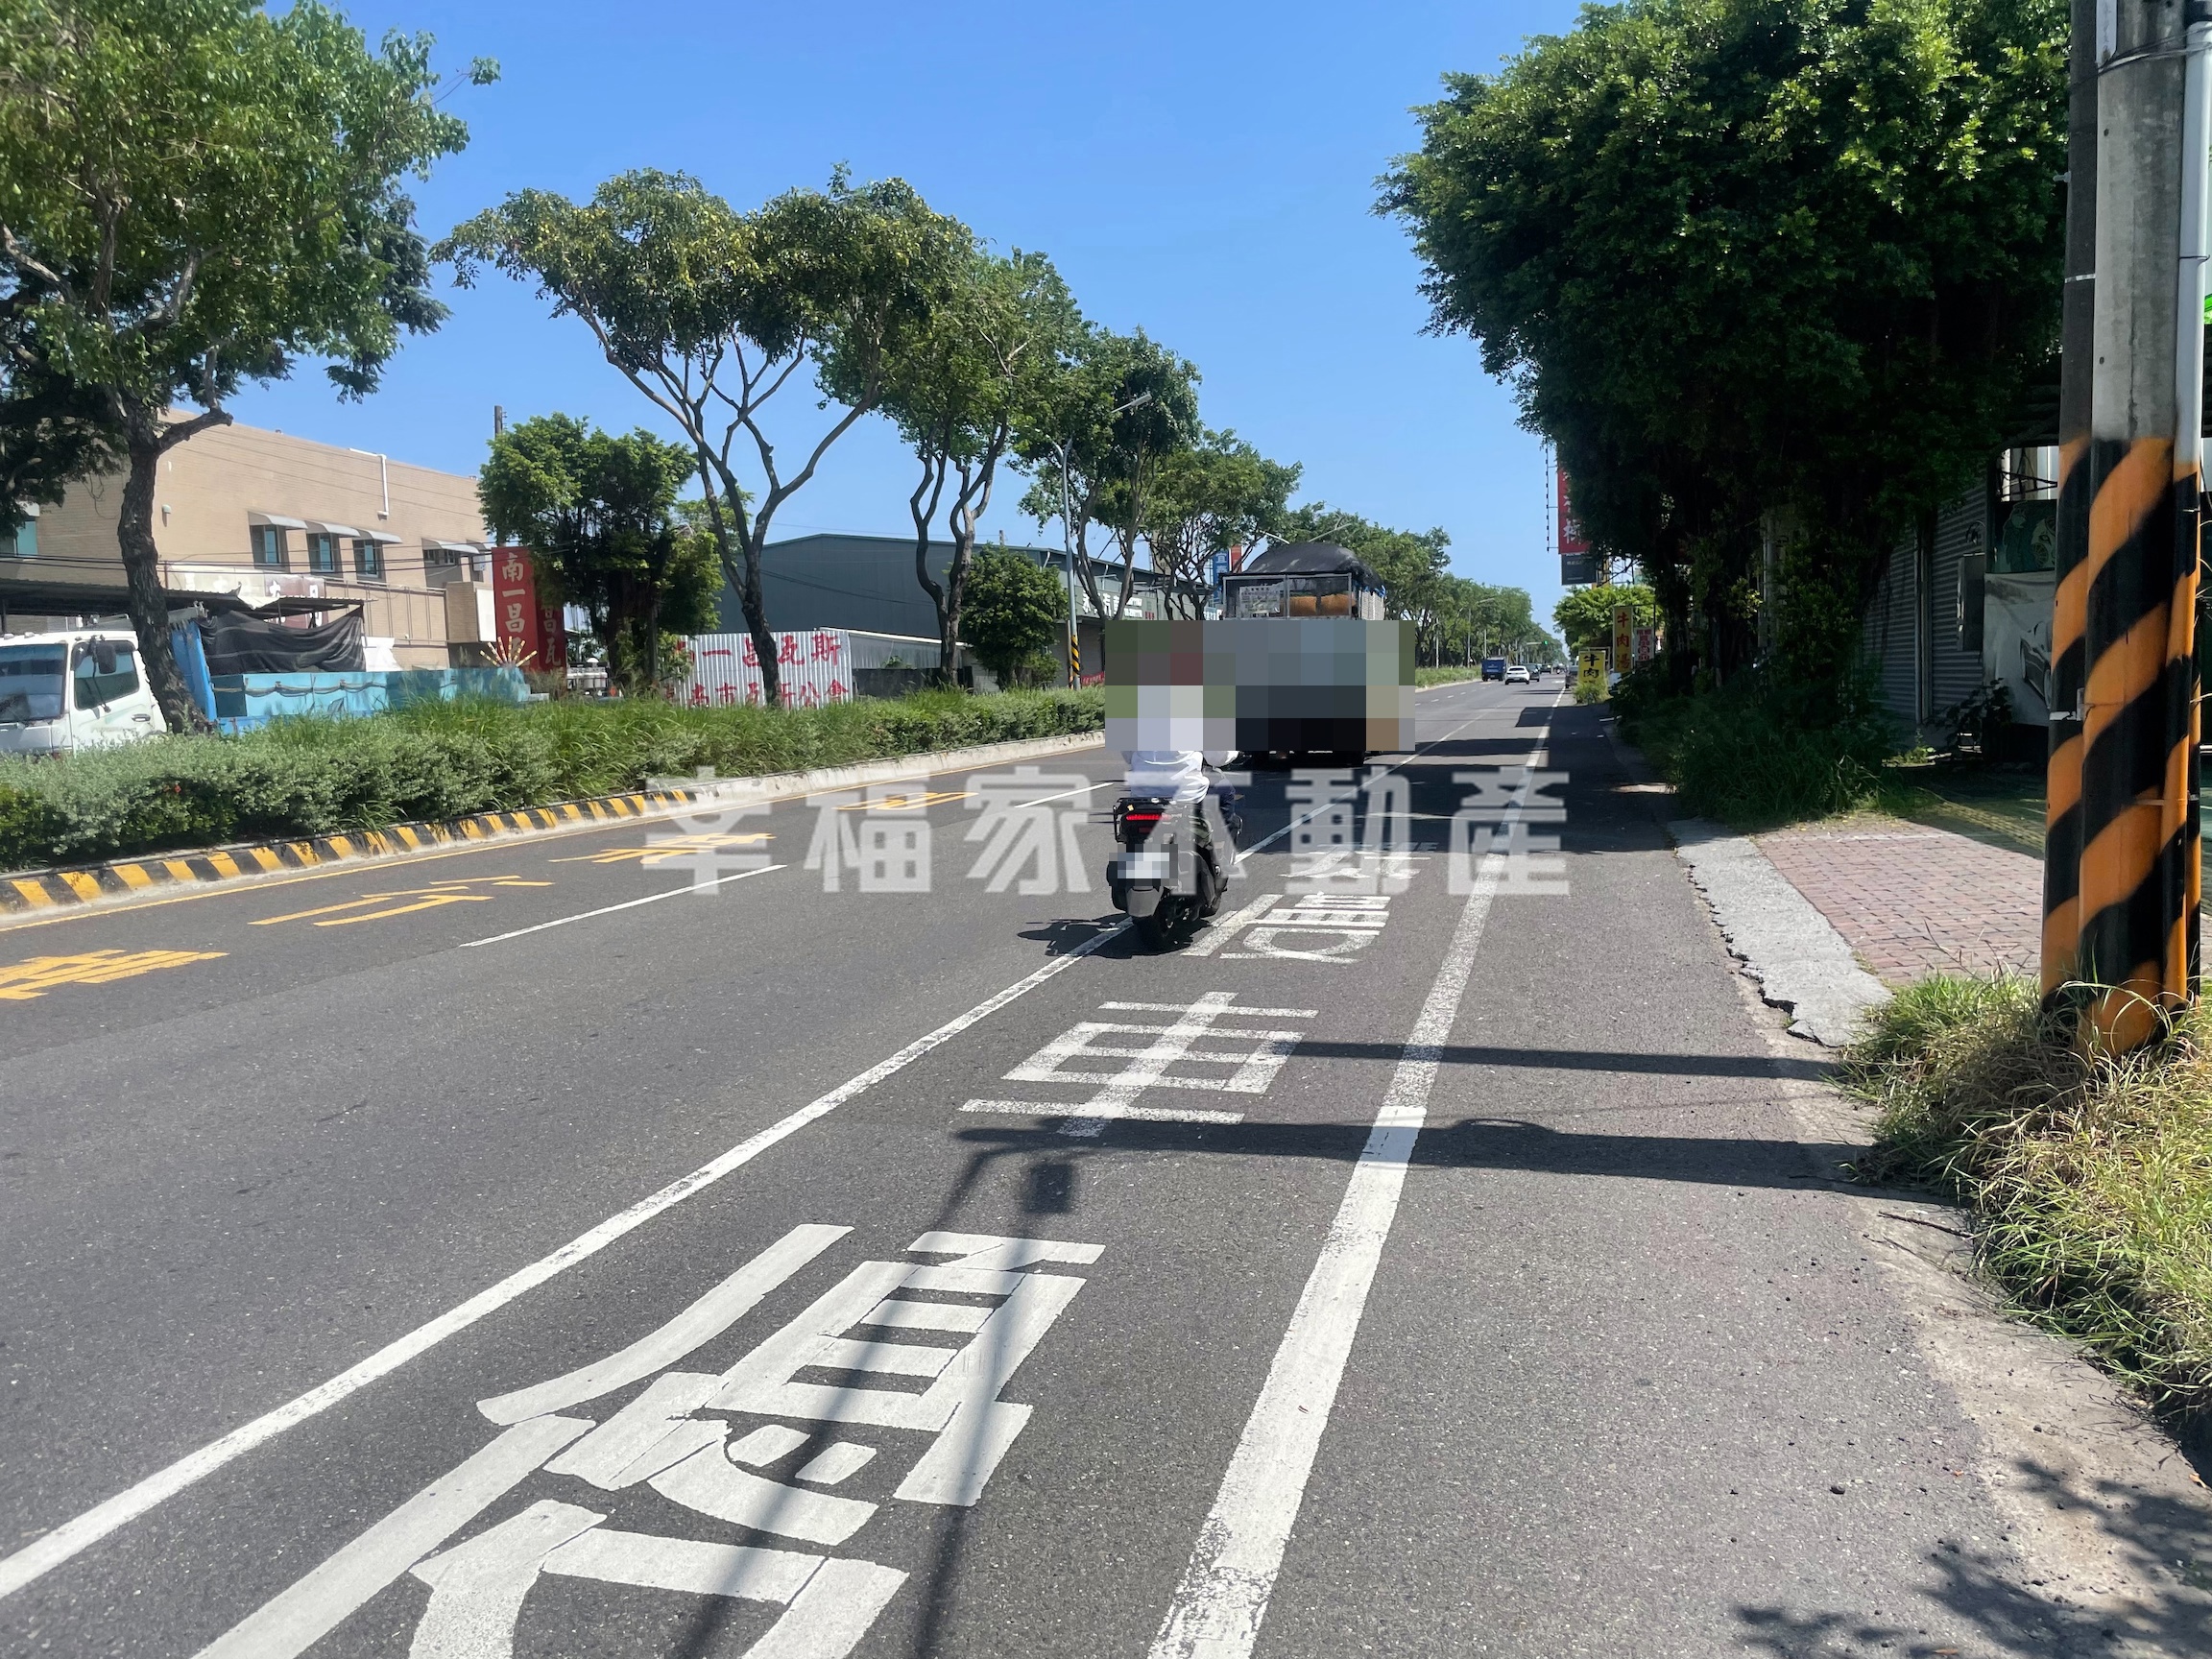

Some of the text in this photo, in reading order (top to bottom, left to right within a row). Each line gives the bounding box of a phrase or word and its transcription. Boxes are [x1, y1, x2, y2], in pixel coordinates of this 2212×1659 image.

[1616, 612, 1630, 669] 牛肉湯
[1583, 654, 1600, 684] 牛肉
